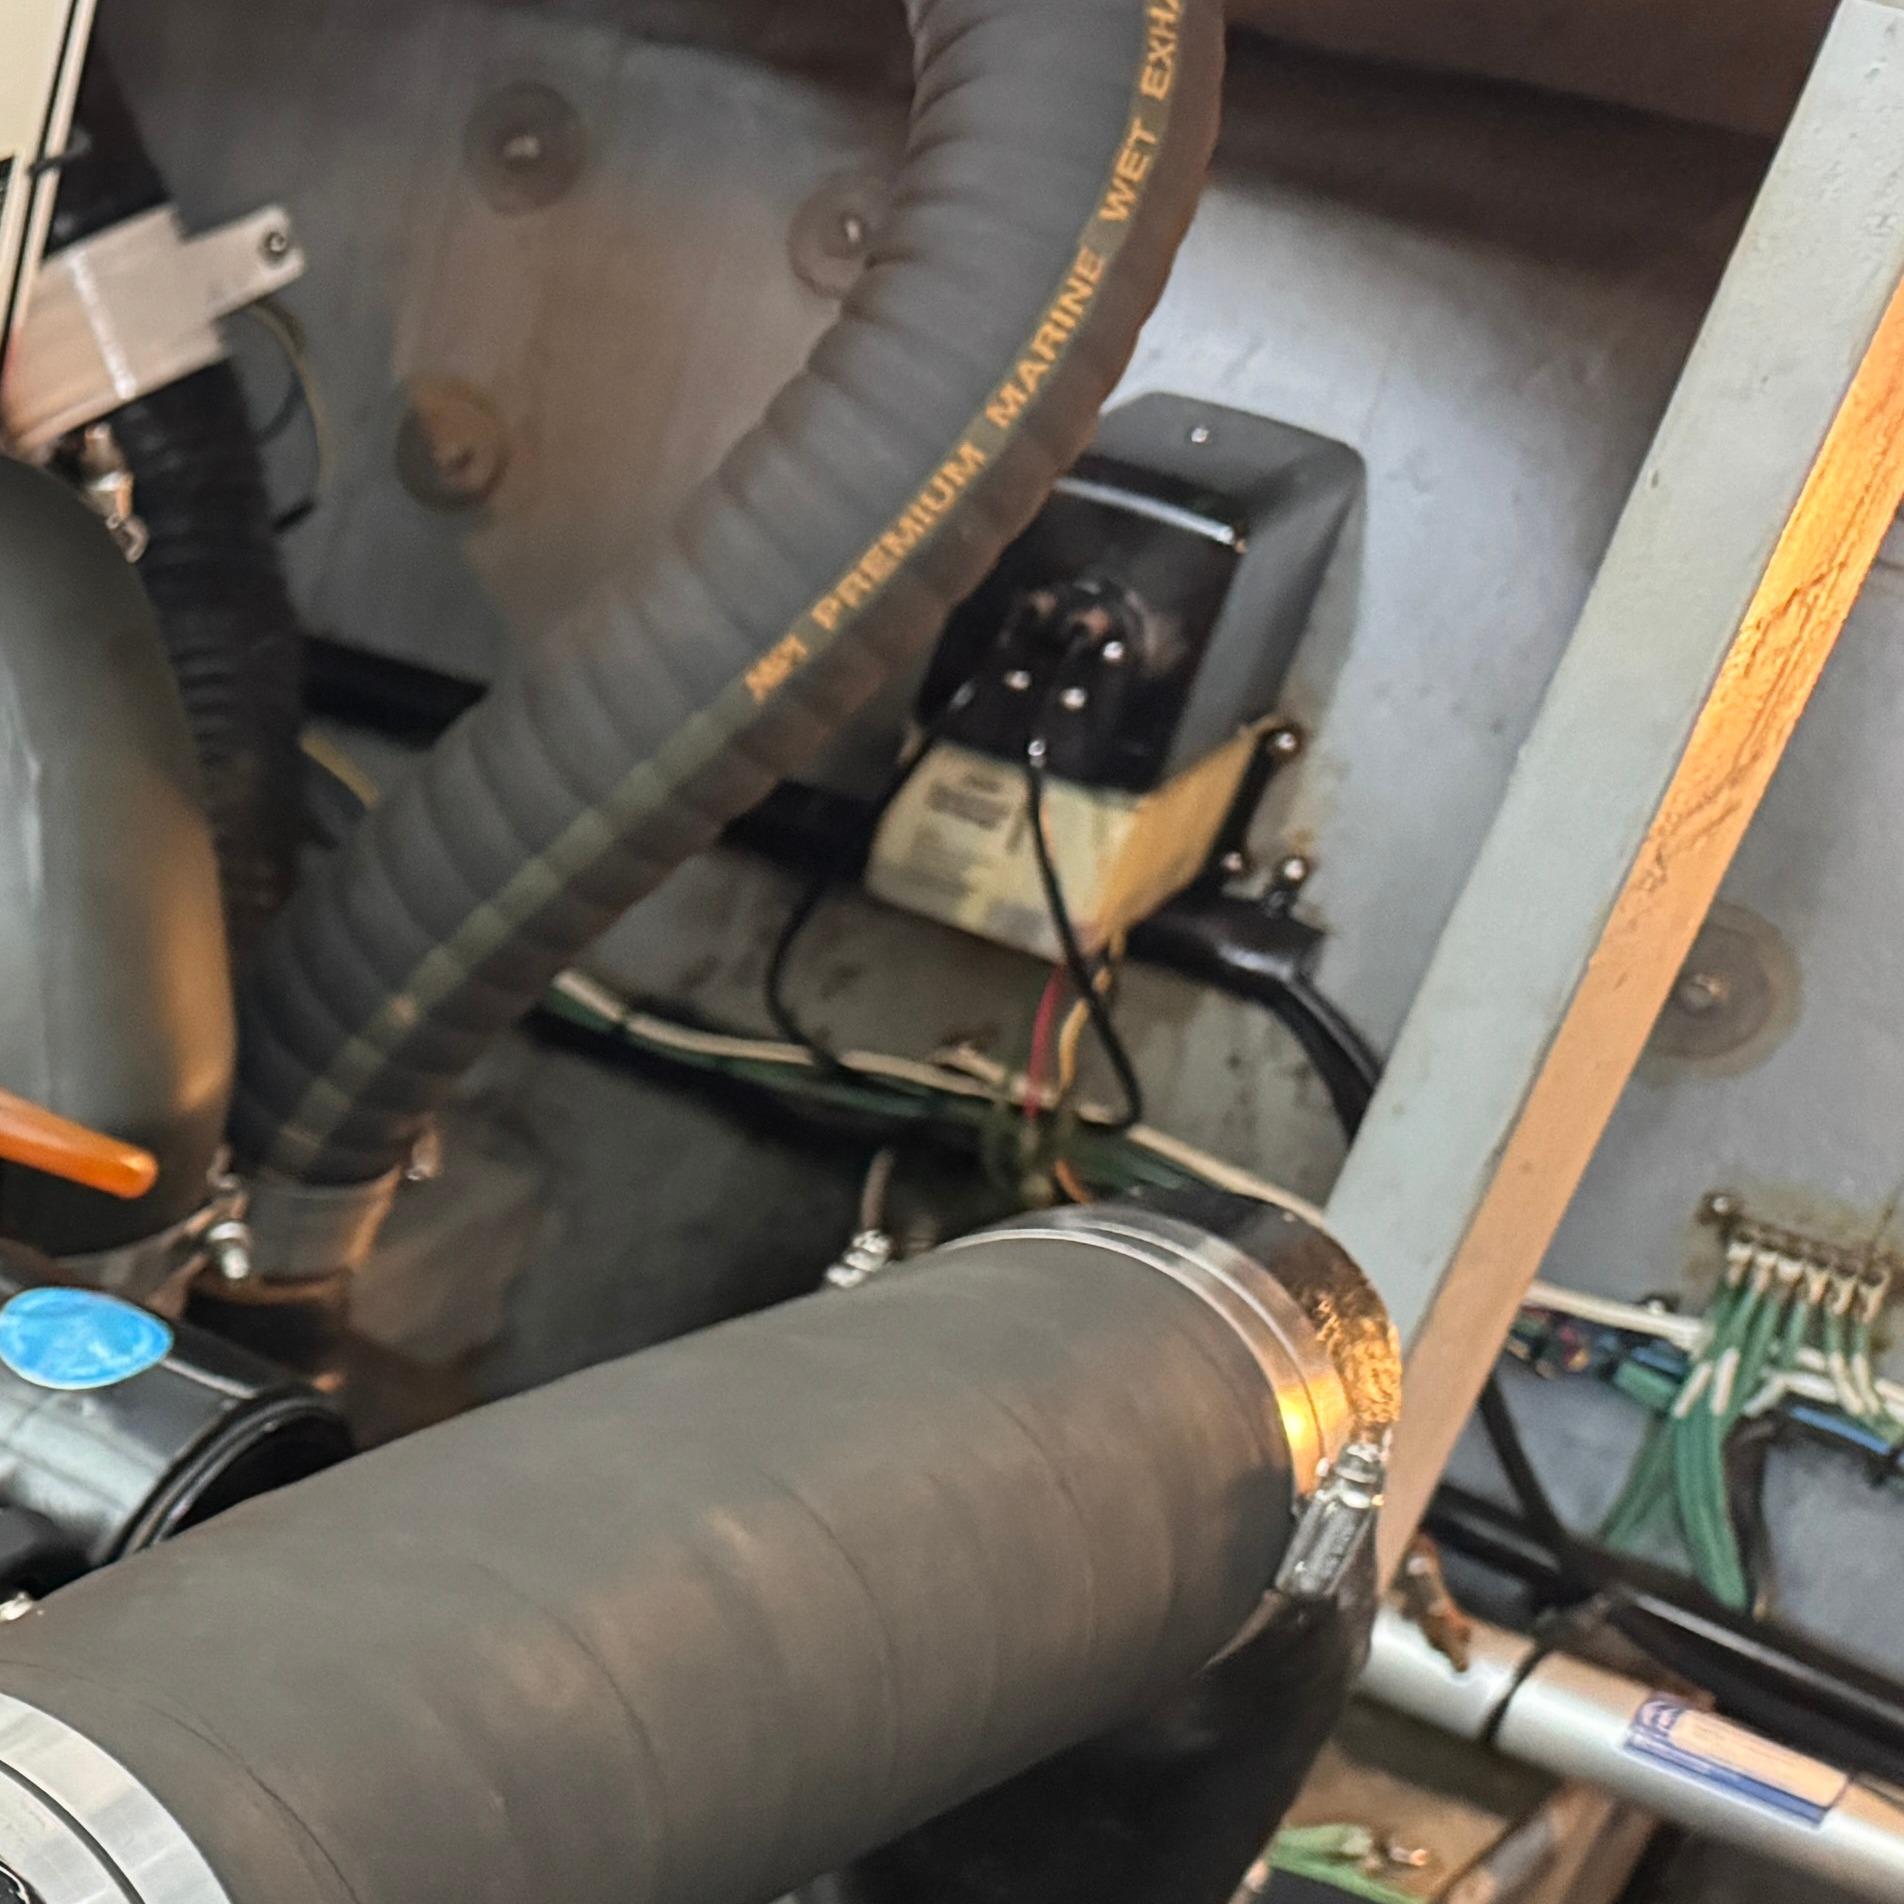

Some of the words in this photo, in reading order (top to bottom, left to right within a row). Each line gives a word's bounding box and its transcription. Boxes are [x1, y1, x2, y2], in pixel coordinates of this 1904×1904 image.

[811, 440, 989, 630] PREMIUM
[985, 246, 1106, 428] MARINE
[1099, 116, 1159, 223] WET
[1140, 0, 1183, 101] EXH
